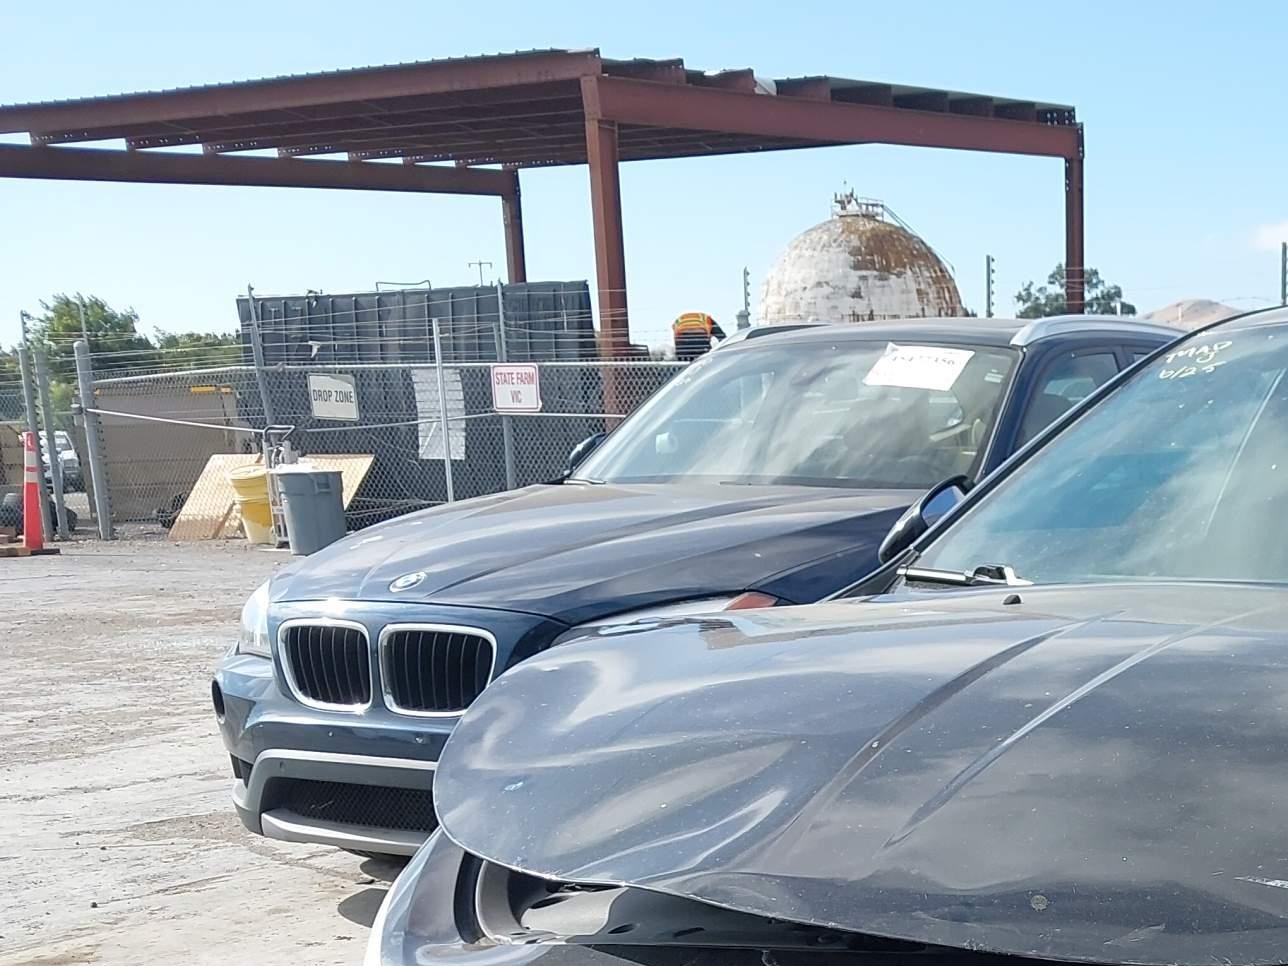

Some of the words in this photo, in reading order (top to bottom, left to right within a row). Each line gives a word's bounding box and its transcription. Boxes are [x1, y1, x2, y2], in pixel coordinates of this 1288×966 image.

[496, 372, 514, 385] STATE
[517, 372, 534, 385] FARM
[313, 389, 332, 402] DROP
[334, 390, 354, 403] ZONE
